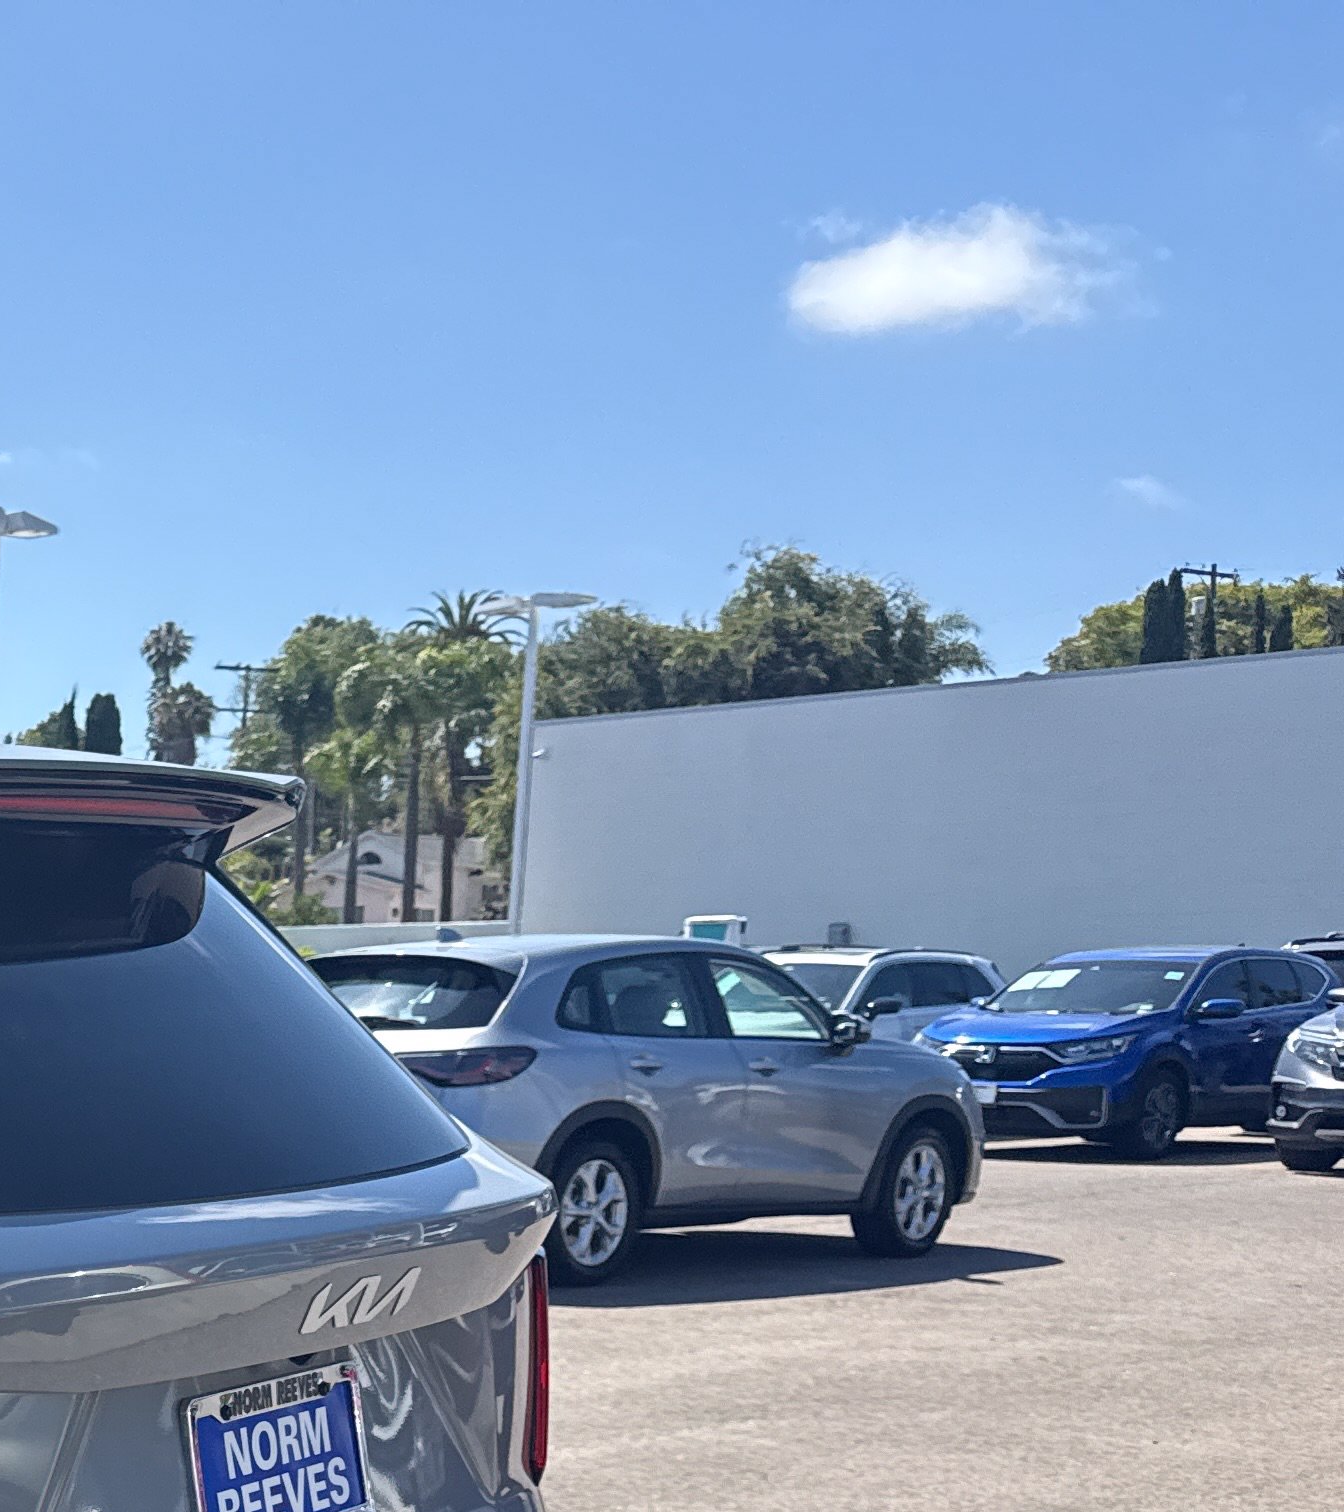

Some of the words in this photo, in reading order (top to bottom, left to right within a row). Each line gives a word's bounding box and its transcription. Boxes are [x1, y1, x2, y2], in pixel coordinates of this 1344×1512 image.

[232, 1384, 273, 1416] NORM
[276, 1371, 323, 1405] REEVES
[223, 1406, 332, 1480] NORM
